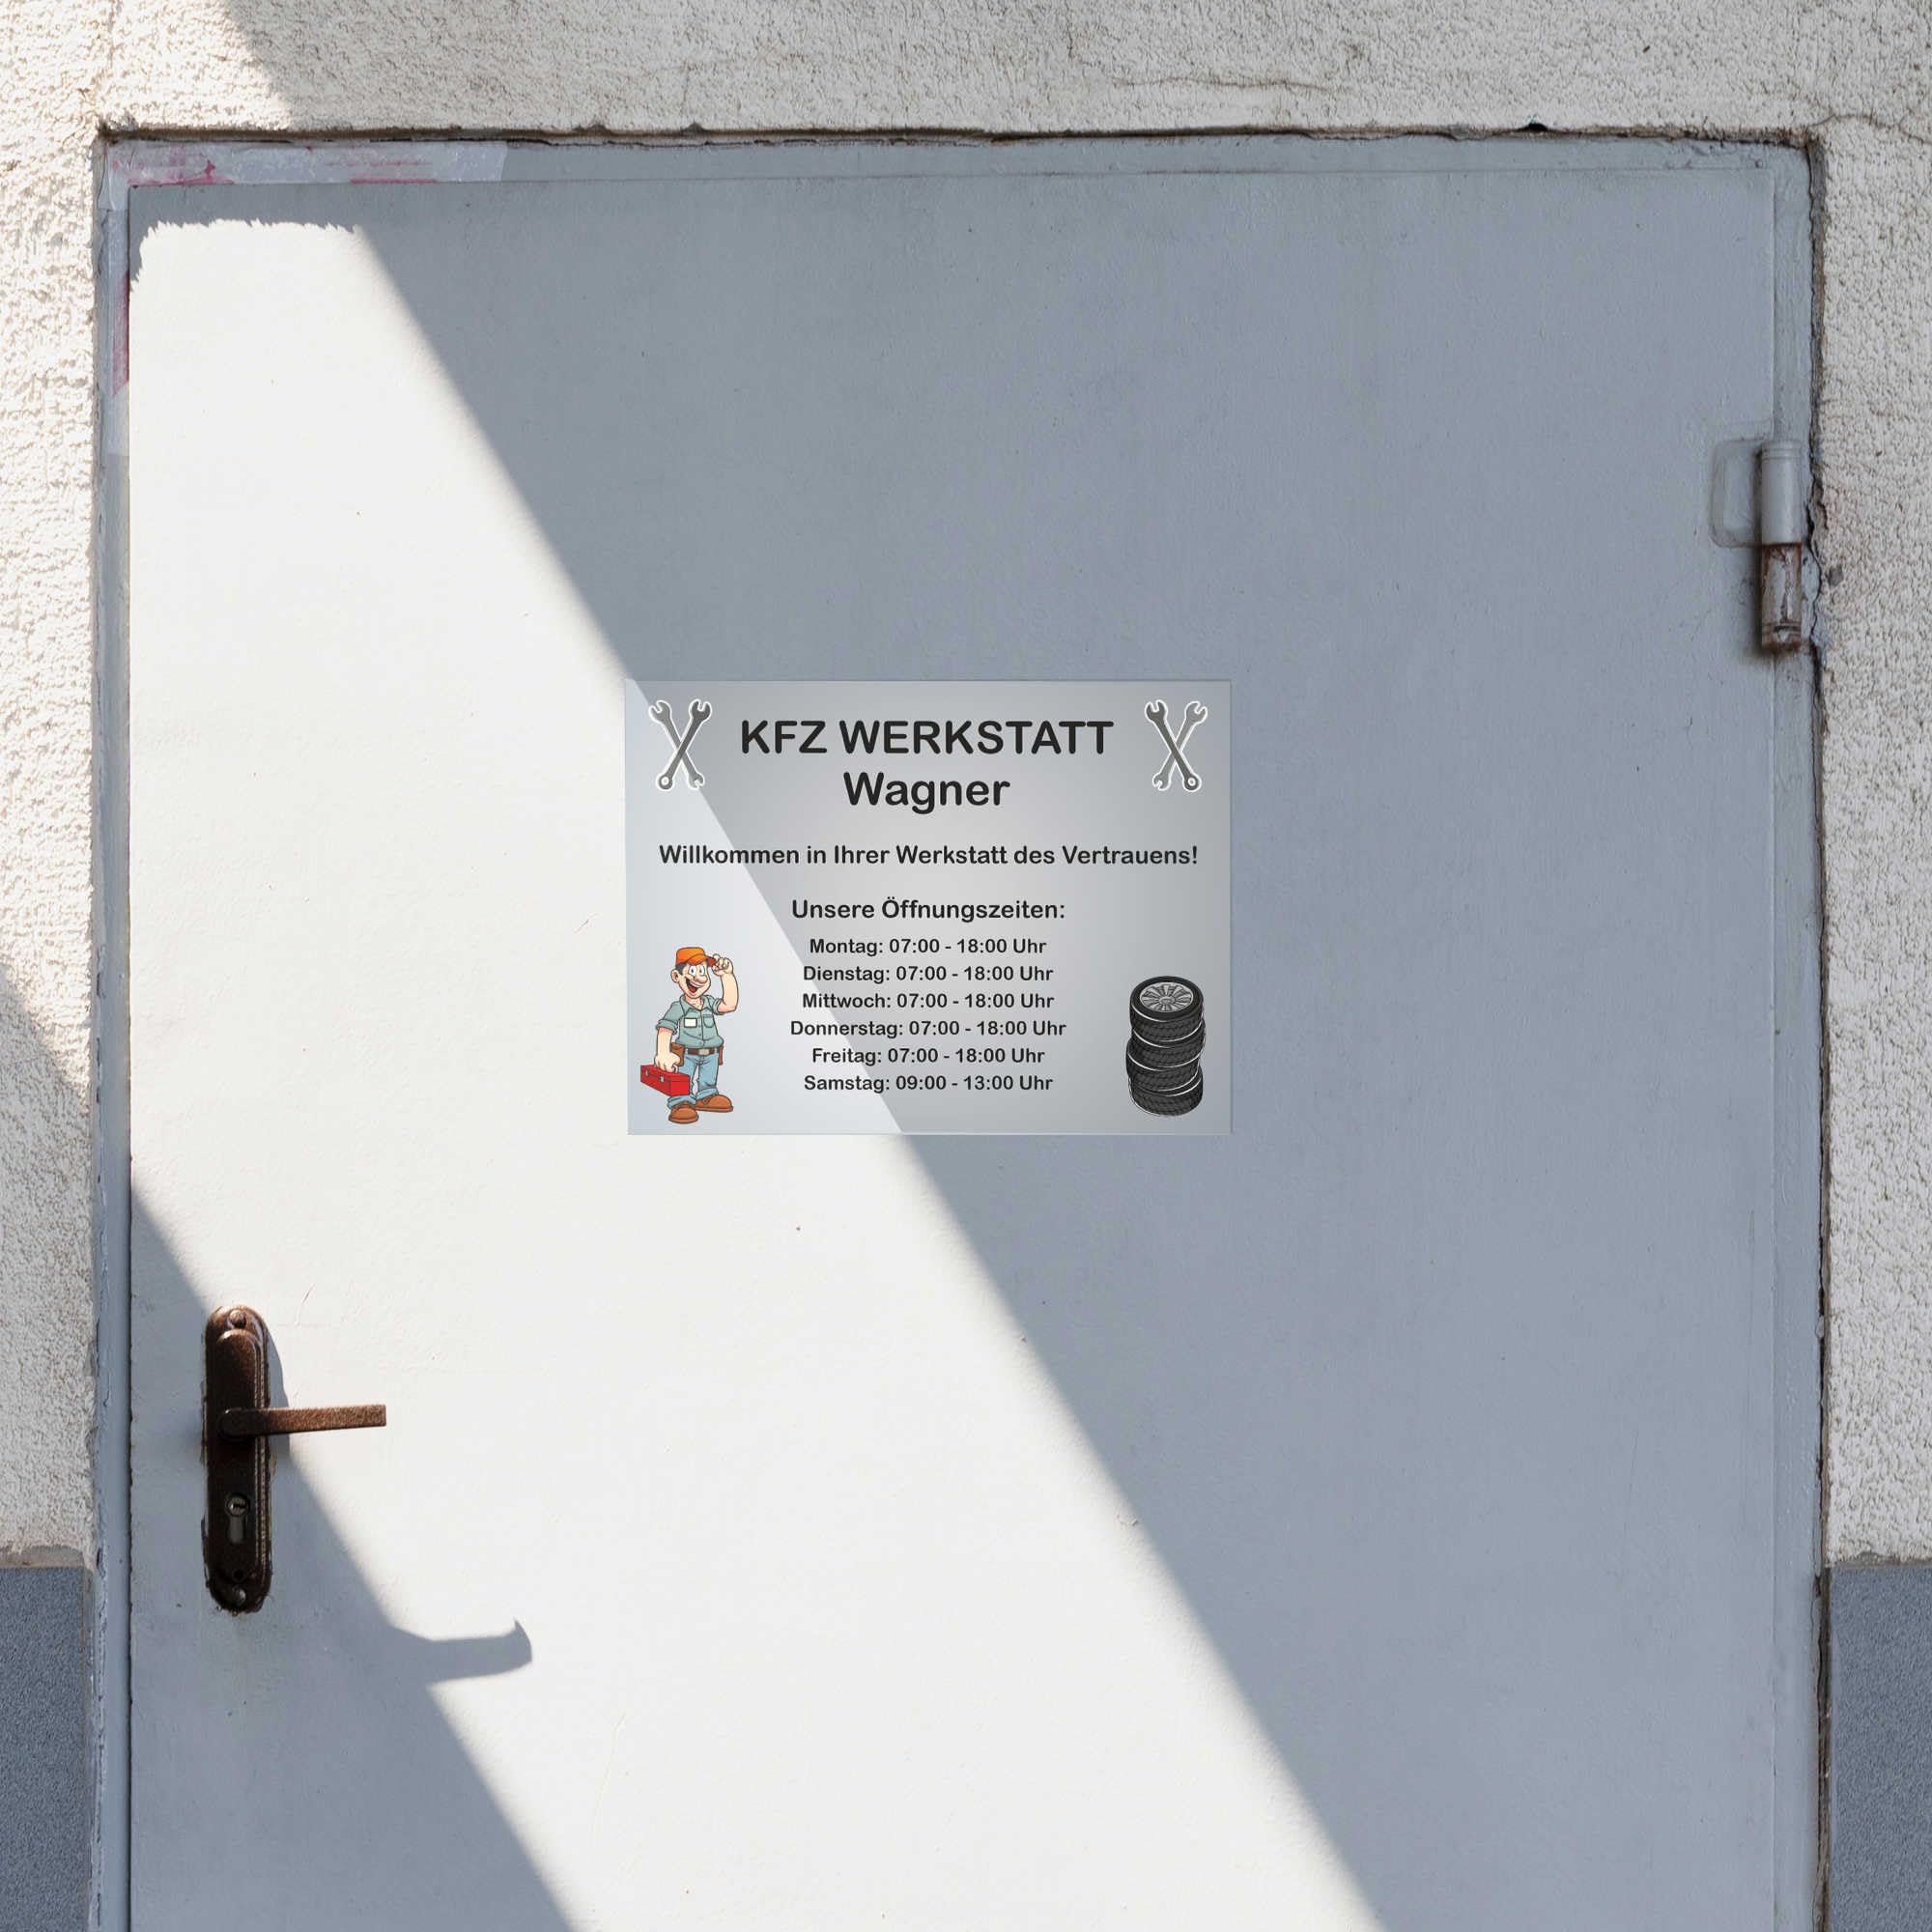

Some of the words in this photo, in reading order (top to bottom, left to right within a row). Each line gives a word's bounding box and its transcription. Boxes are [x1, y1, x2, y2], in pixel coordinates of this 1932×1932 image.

[741, 720, 828, 754] KFZ
[838, 720, 1115, 755] WERKSTATT
[842, 771, 1011, 815] Wagner
[659, 844, 800, 865] Willkommen
[807, 845, 827, 865] in
[834, 844, 891, 865] Ihrer
[895, 844, 1009, 865] Werkstatt
[1013, 845, 1055, 865] des
[1062, 845, 1198, 865] Vertrauens!
[792, 899, 875, 919] Unsere
[881, 895, 1065, 923] Öffnungszeiten:
[810, 938, 884, 957] Montag:
[889, 938, 940, 953] 07:00
[956, 938, 1008, 953] 18:00
[1012, 938, 1047, 953] Uhr
[804, 965, 891, 985] Dienstag:
[895, 965, 947, 981] 07:00
[964, 965, 1014, 981] 18:00
[1019, 965, 1054, 981] Uhr
[803, 992, 892, 1009] Mittwoch:
[896, 993, 948, 1009] 07:00
[964, 993, 1015, 1009] 18:00
[1020, 993, 1055, 1009] Uhr
[790, 1020, 904, 1039] Donnerstag:
[909, 1020, 960, 1036] 07:00
[977, 1020, 1027, 1036] 18:00
[1033, 1020, 1067, 1037] Uhr
[812, 1047, 883, 1067] Freitag:
[888, 1047, 939, 1064] 07:00
[955, 1047, 1006, 1064] 18:00
[1011, 1047, 1045, 1064] Uhr
[804, 1075, 891, 1094] Samstag:
[895, 1075, 947, 1091] 09:00
[963, 1075, 1014, 1091] 13:00
[1019, 1074, 1054, 1091] Uhr
